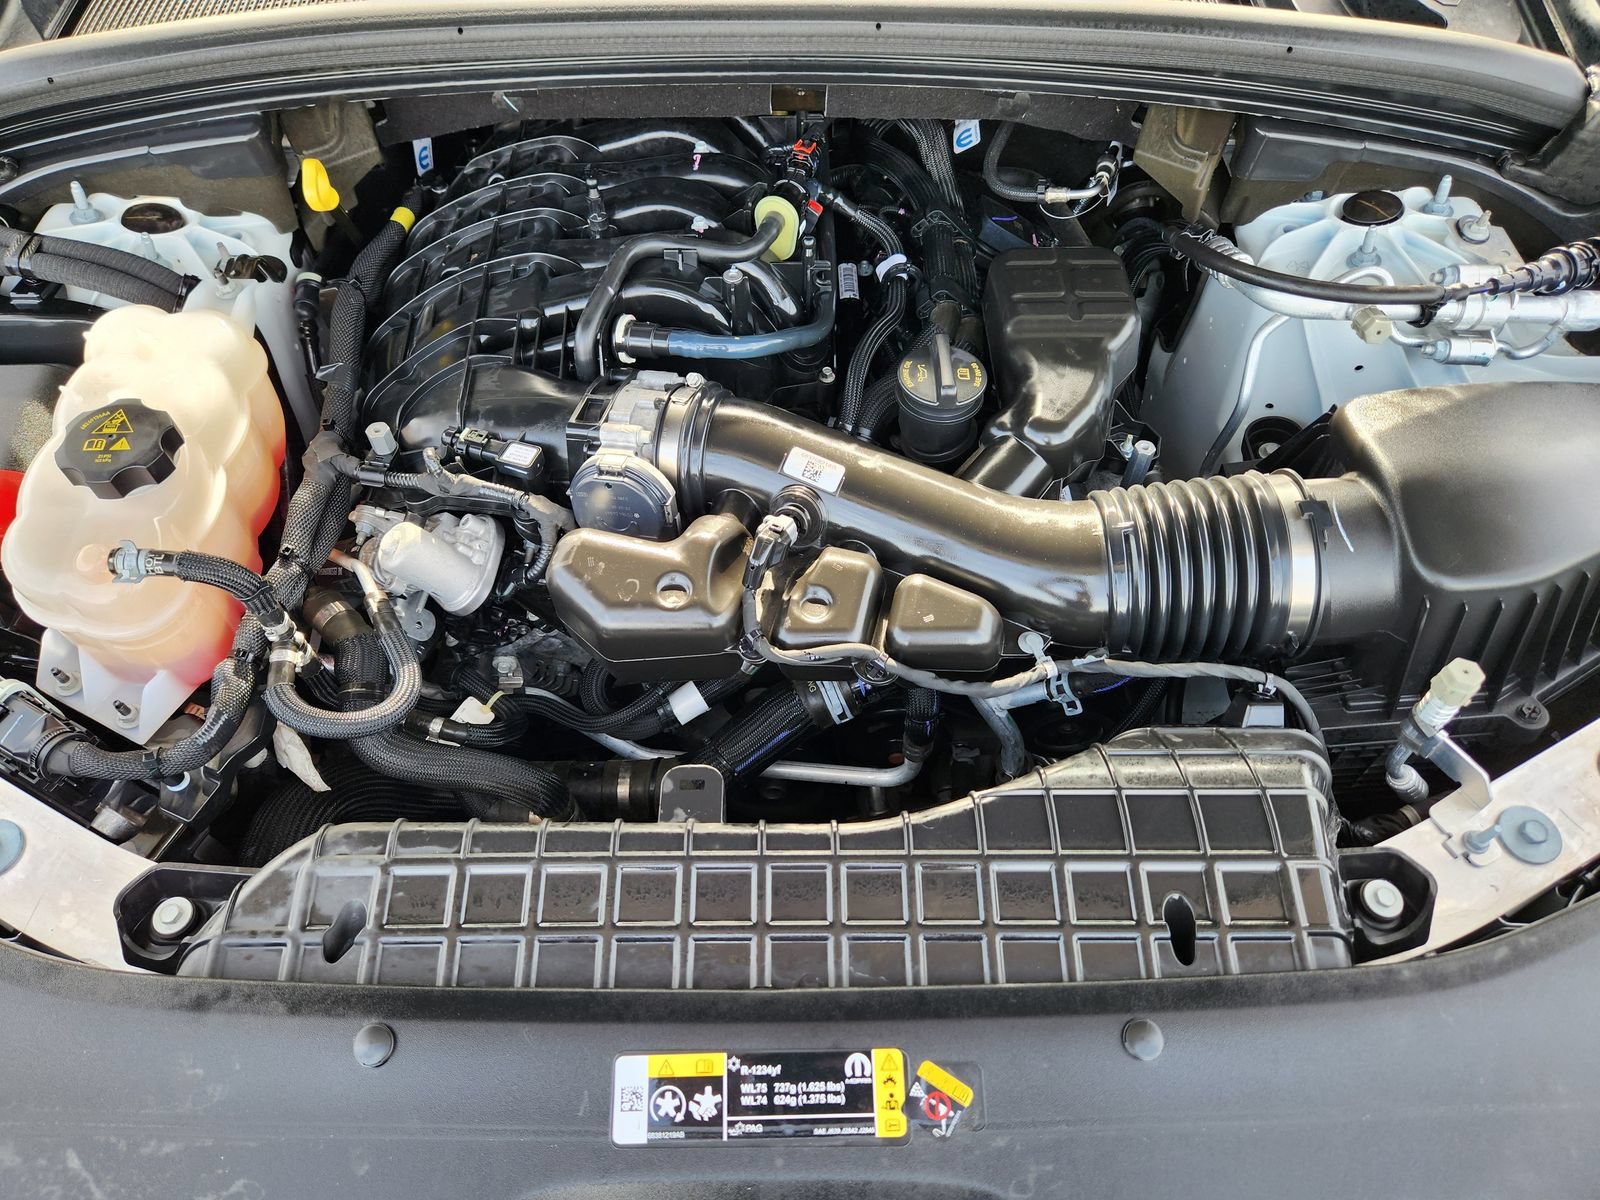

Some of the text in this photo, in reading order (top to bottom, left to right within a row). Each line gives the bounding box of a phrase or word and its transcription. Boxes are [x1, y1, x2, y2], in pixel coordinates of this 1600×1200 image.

[154, 554, 165, 574] BTL
[740, 1064, 782, 1077] R-1234yf
[740, 1081, 846, 1095] WL75 737g (1.625 lbs)
[740, 1093, 846, 1107] WL74 624g (1.375 lbs)
[746, 1123, 763, 1133] PAG
